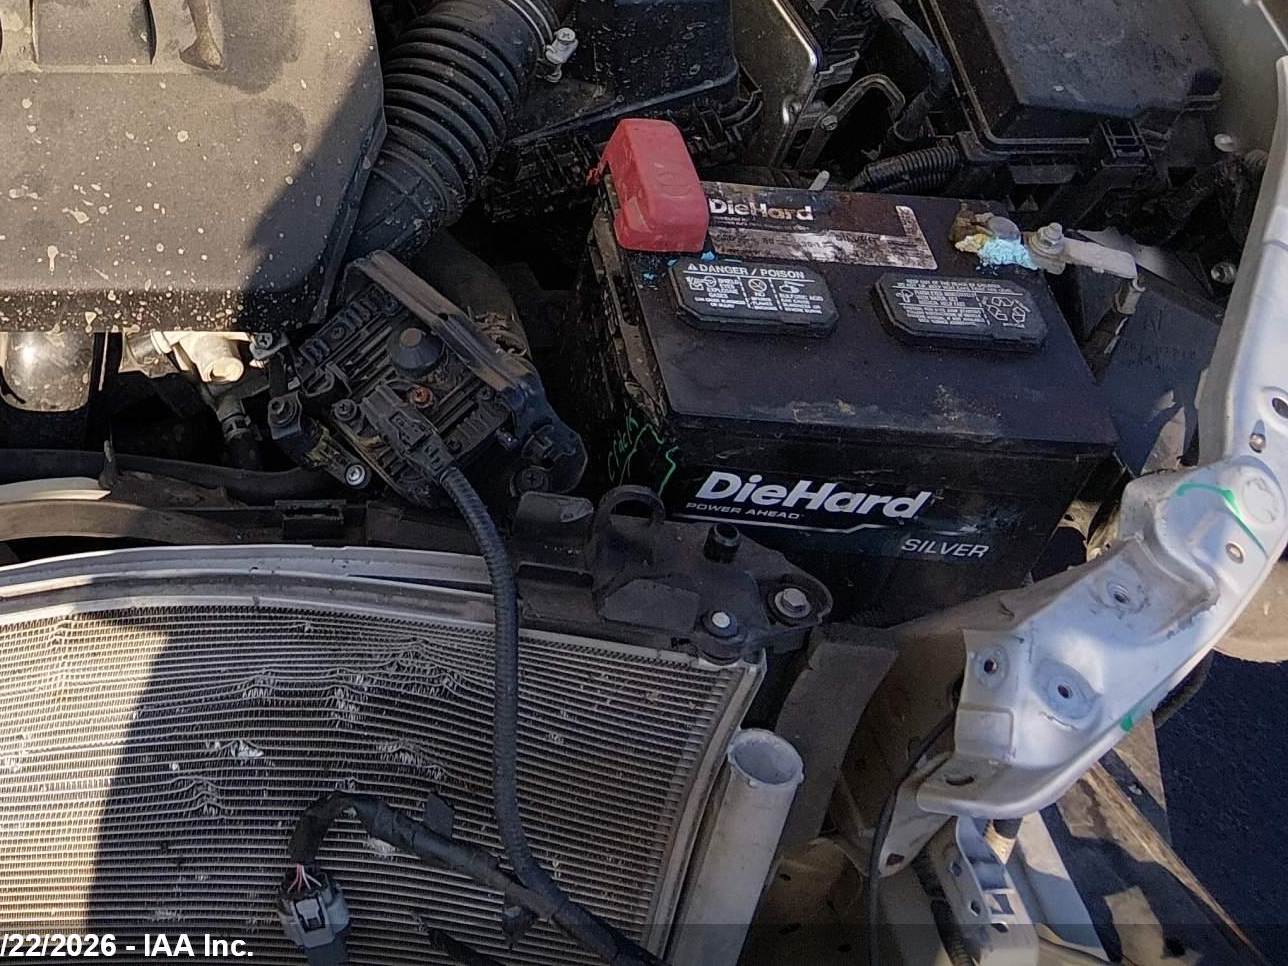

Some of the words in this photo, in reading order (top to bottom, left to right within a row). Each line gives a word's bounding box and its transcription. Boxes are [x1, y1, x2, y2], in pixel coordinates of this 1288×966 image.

[709, 199, 813, 221] DieHard
[699, 264, 748, 275] DANGER
[761, 269, 805, 279] POISON
[696, 471, 932, 519] DieHard
[685, 502, 742, 514] POWER
[745, 508, 801, 520] AHEAD
[901, 538, 990, 559] SILVER
